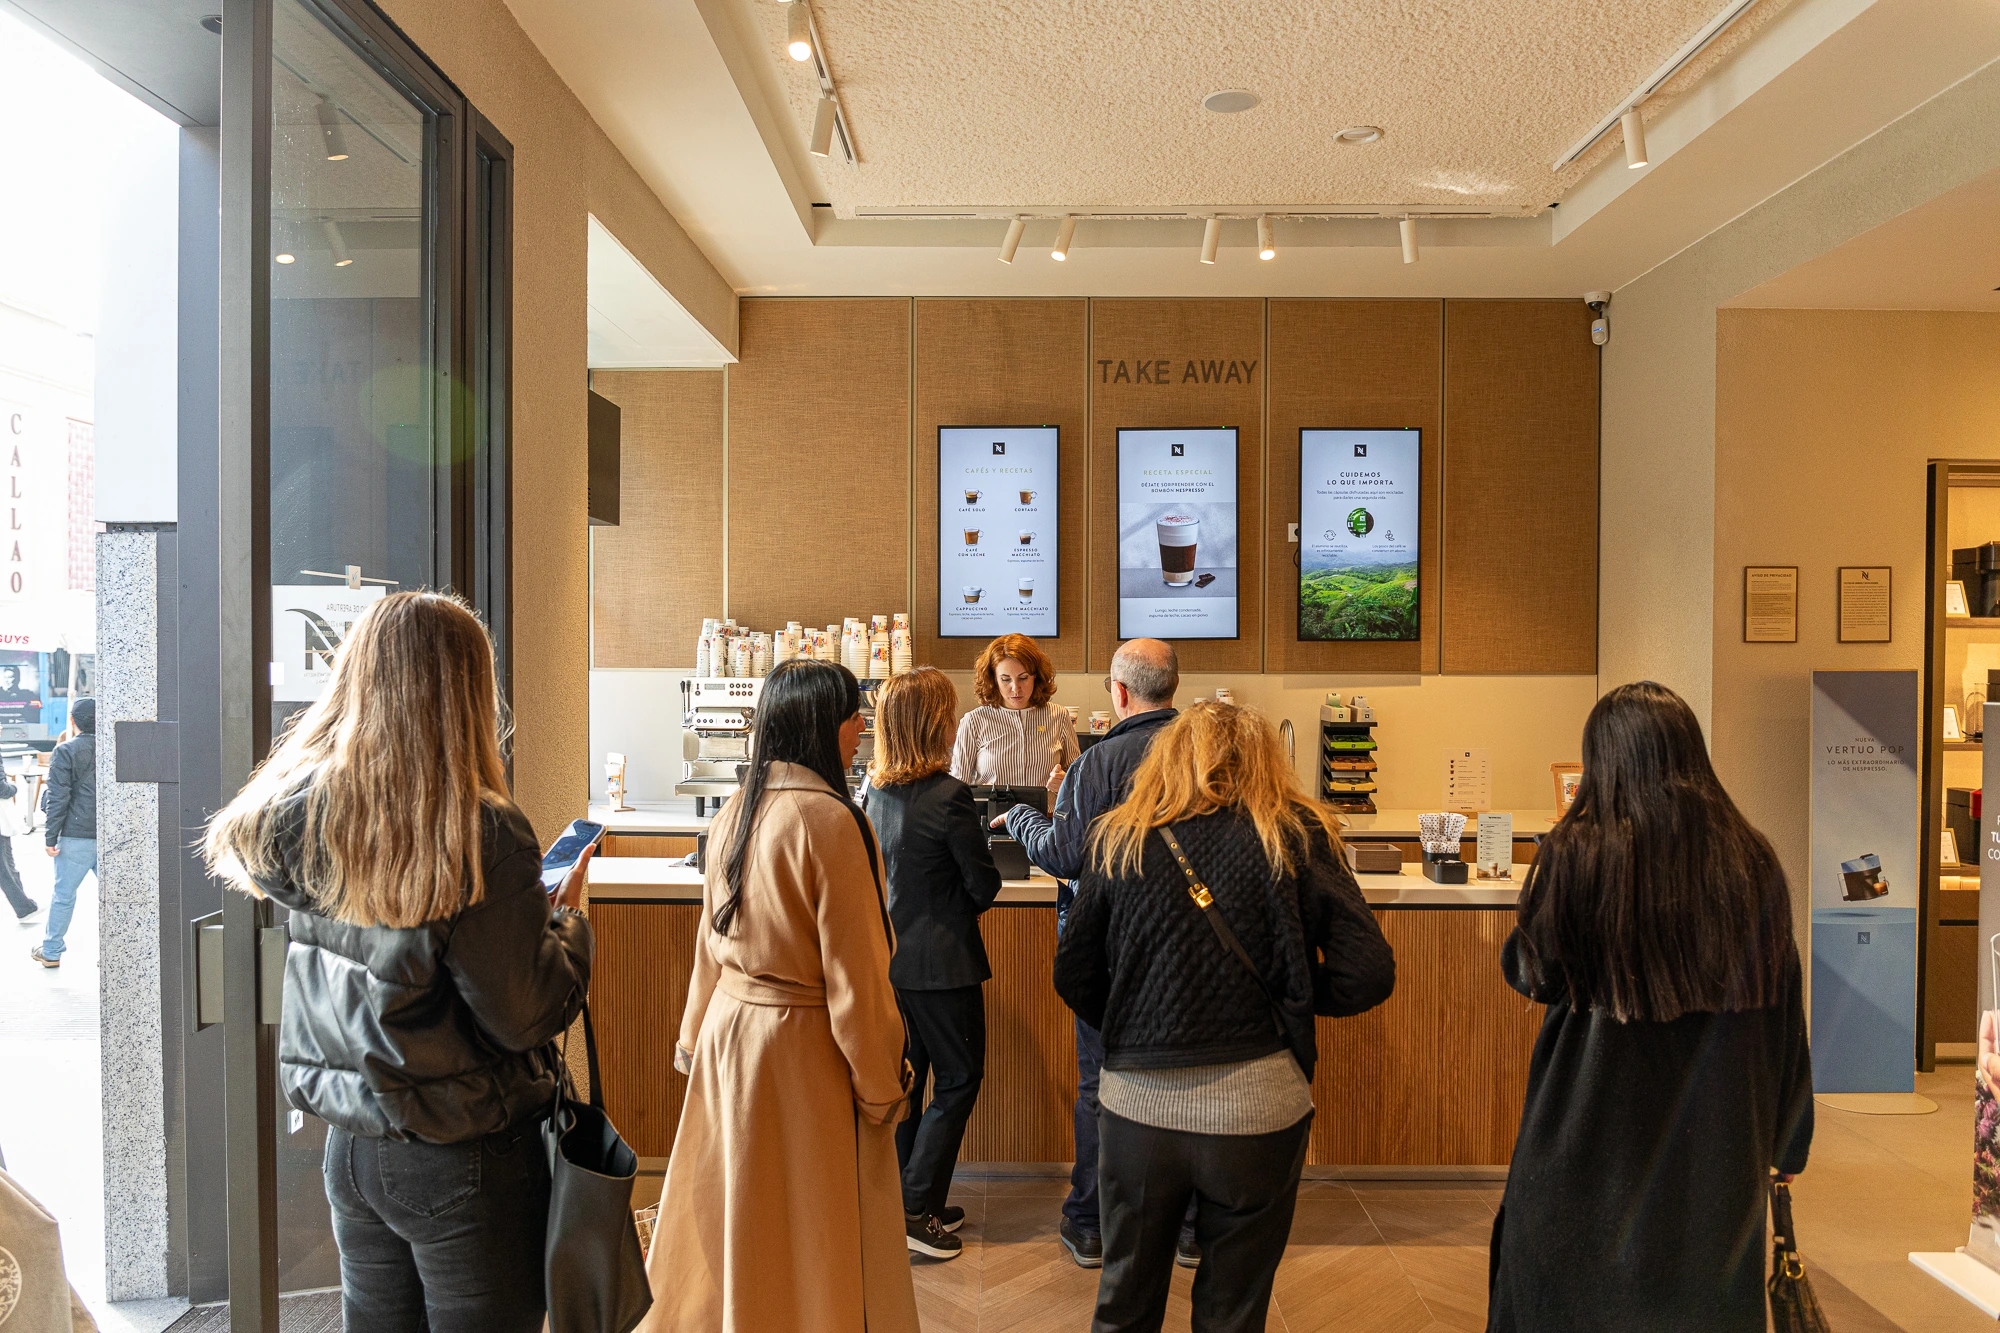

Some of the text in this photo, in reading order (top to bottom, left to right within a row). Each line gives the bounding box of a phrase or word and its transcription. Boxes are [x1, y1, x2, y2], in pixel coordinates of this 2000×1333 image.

[1097, 360, 1258, 384] TAKE AWAY
[10, 413, 22, 593] CALLAO
[1826, 746, 1904, 754] VERTUO POP
